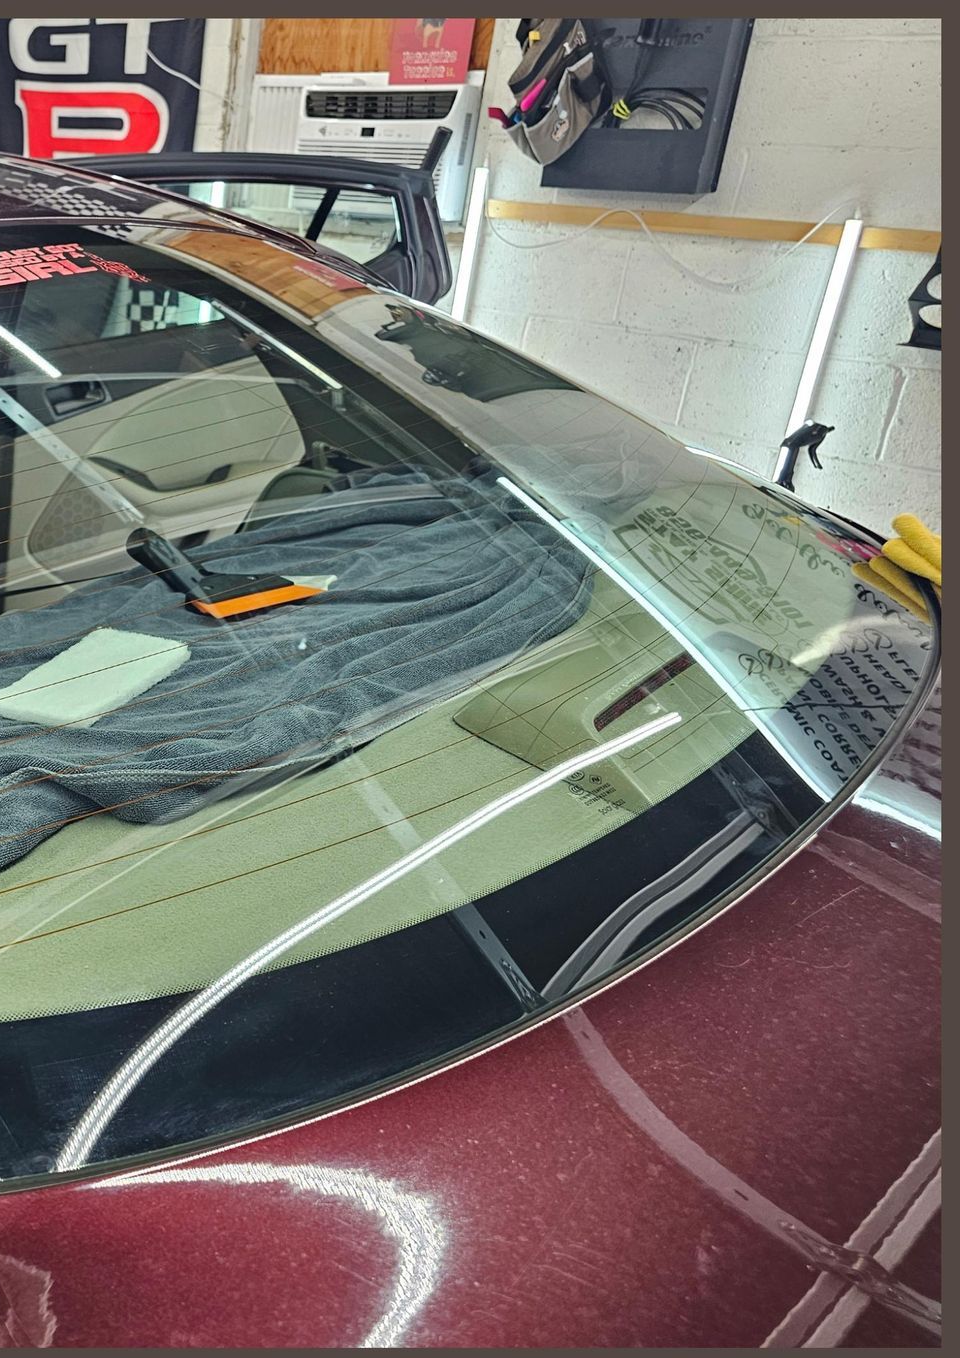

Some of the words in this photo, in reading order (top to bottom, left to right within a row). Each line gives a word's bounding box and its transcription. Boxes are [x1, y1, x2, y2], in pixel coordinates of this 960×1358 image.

[8, 18, 185, 75] GT
[42, 243, 86, 256] GOT
[41, 252, 69, 264] BY
